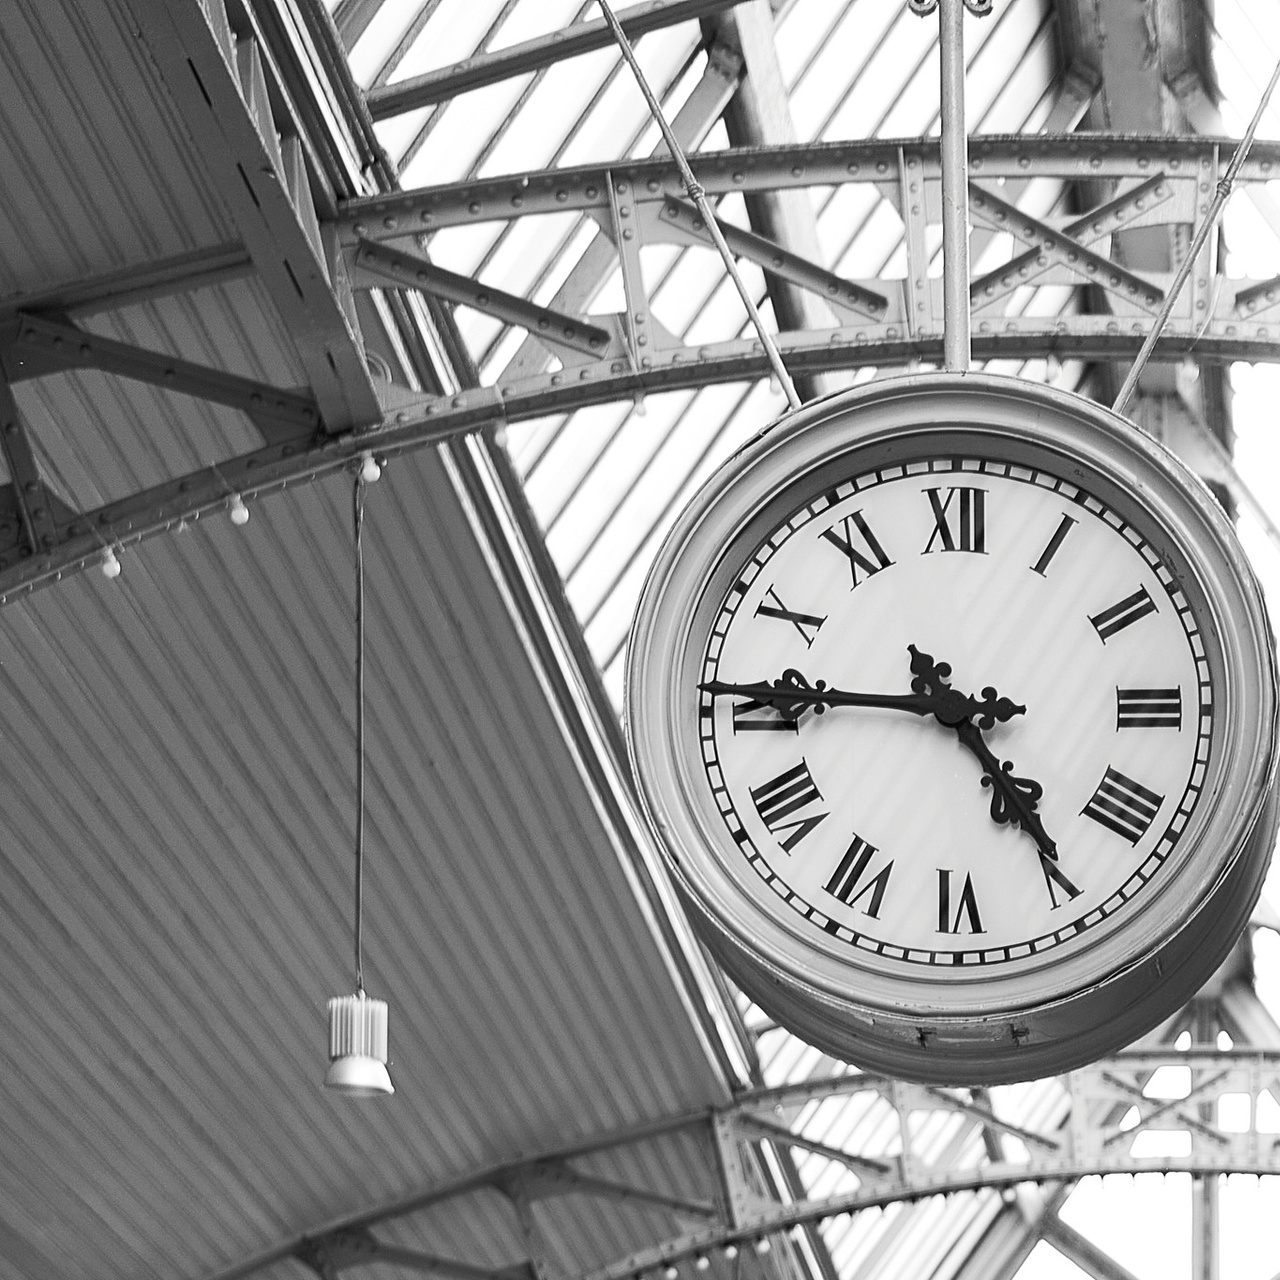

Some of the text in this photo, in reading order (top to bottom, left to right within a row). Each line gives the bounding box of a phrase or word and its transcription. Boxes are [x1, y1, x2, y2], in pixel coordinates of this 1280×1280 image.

[818, 509, 896, 591] XI
[921, 487, 989, 555] XII
[1029, 512, 1079, 578] I
[754, 584, 828, 649] X
[1087, 583, 1159, 645] II
[1116, 685, 1182, 732] III
[749, 757, 829, 856] VIII
[1079, 765, 1165, 848] IIII
[822, 832, 894, 920] VII
[936, 869, 987, 935] VI
[1037, 849, 1085, 911] V
